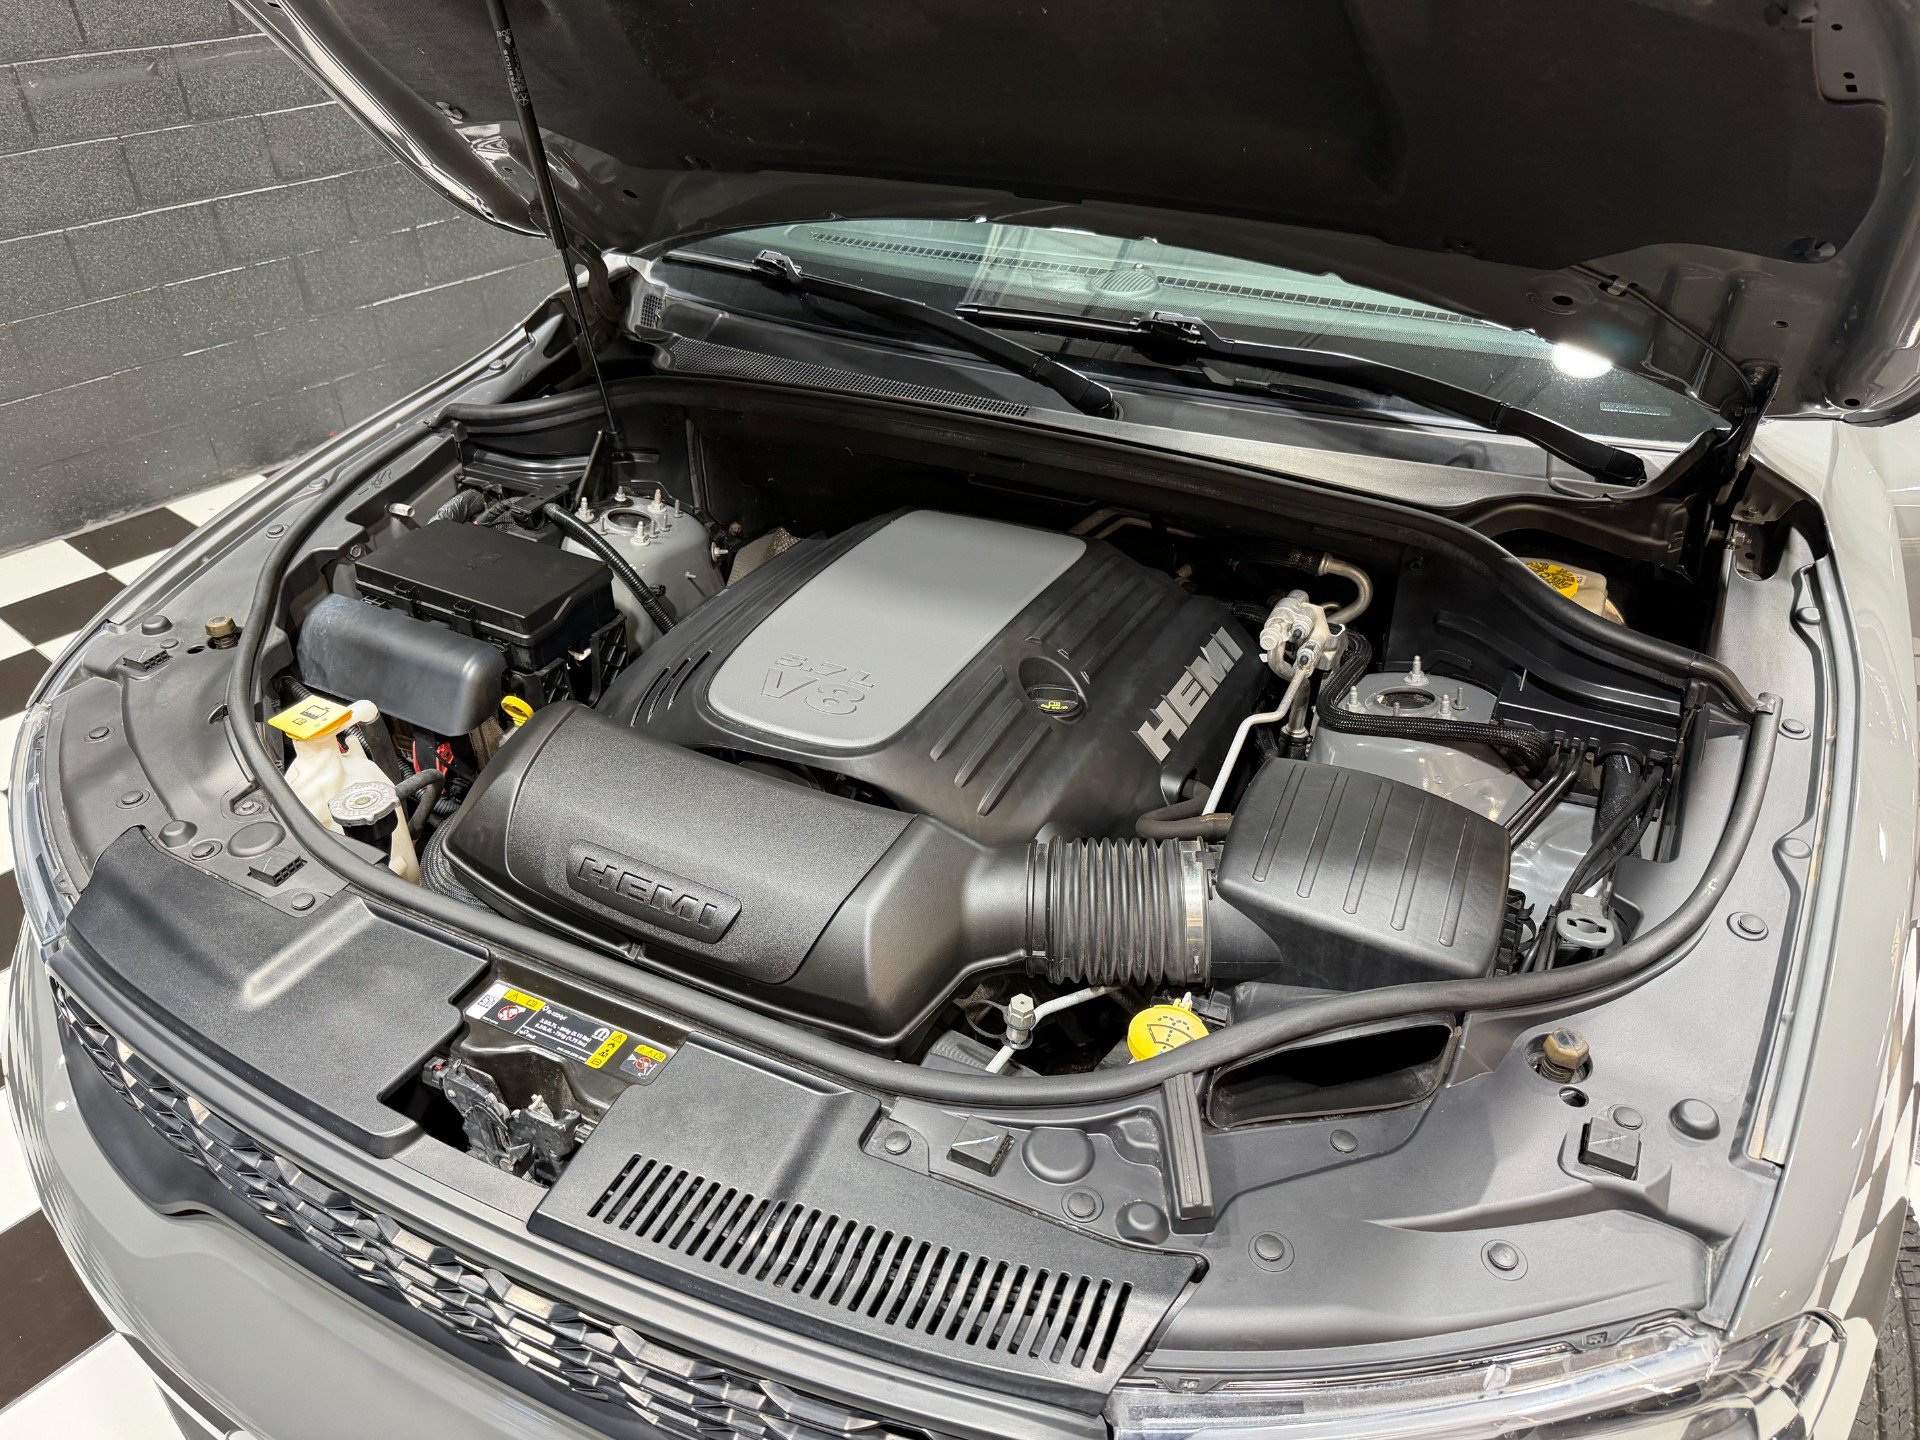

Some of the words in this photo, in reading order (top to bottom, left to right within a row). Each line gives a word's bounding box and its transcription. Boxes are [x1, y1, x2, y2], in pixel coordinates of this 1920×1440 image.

[496, 28, 511, 37] BOD
[761, 666, 866, 716] V8
[1131, 626, 1244, 764] HEMI
[577, 856, 718, 930] HEMI
